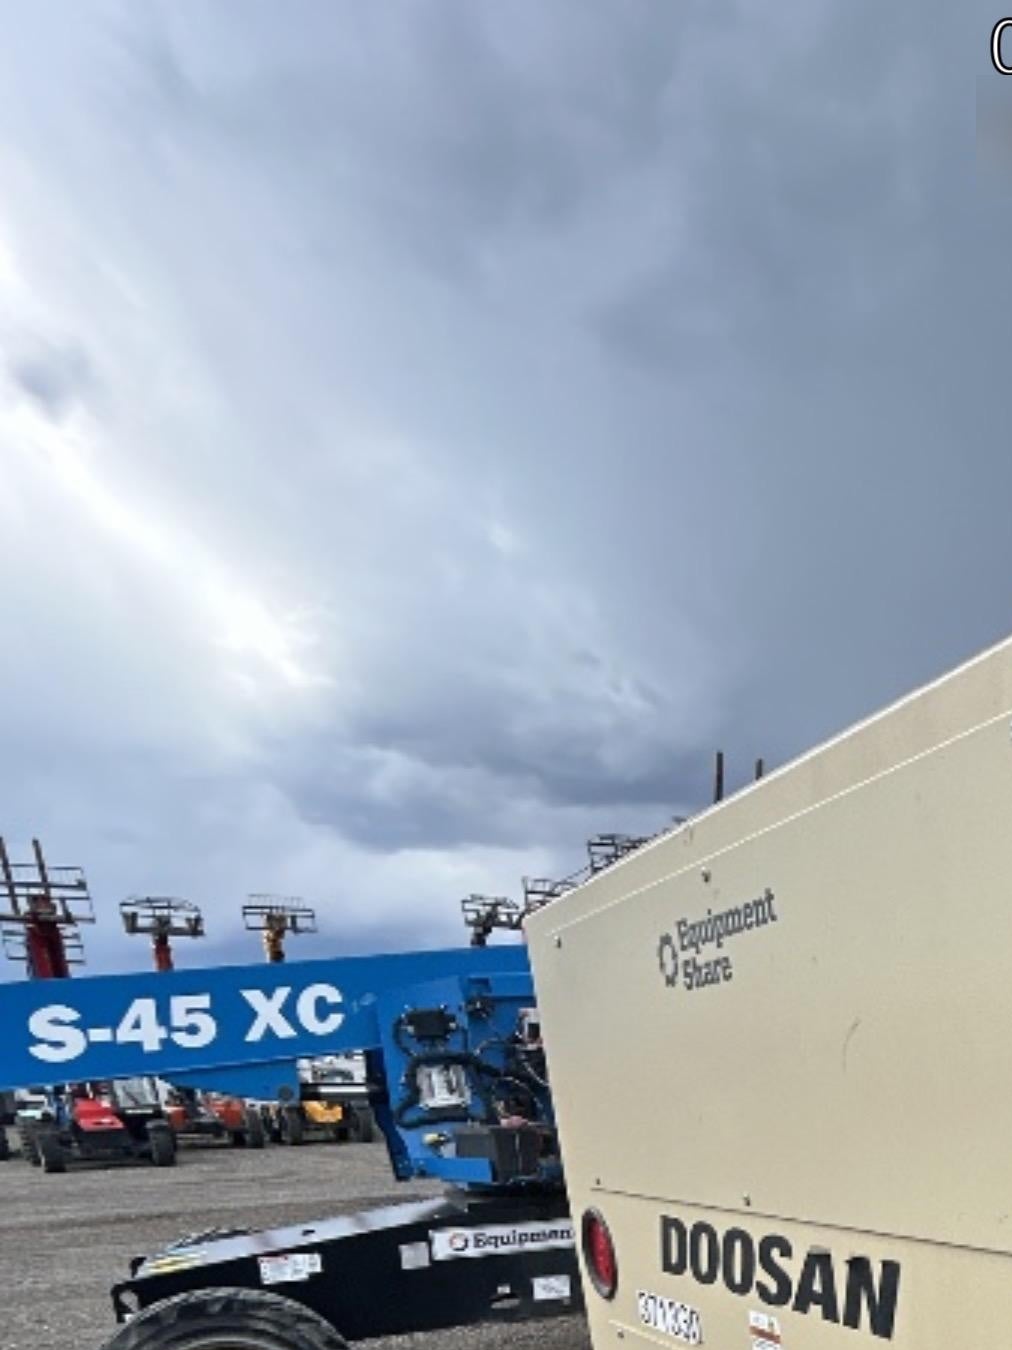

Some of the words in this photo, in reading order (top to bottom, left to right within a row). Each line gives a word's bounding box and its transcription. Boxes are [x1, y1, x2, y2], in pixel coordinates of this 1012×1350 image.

[676, 887, 777, 954] Equipment
[683, 956, 733, 990] Share
[28, 992, 217, 1063] S-45
[239, 983, 345, 1042] XC
[472, 1227, 574, 1249] Equipmen
[660, 1214, 900, 1340] DOOSAN
